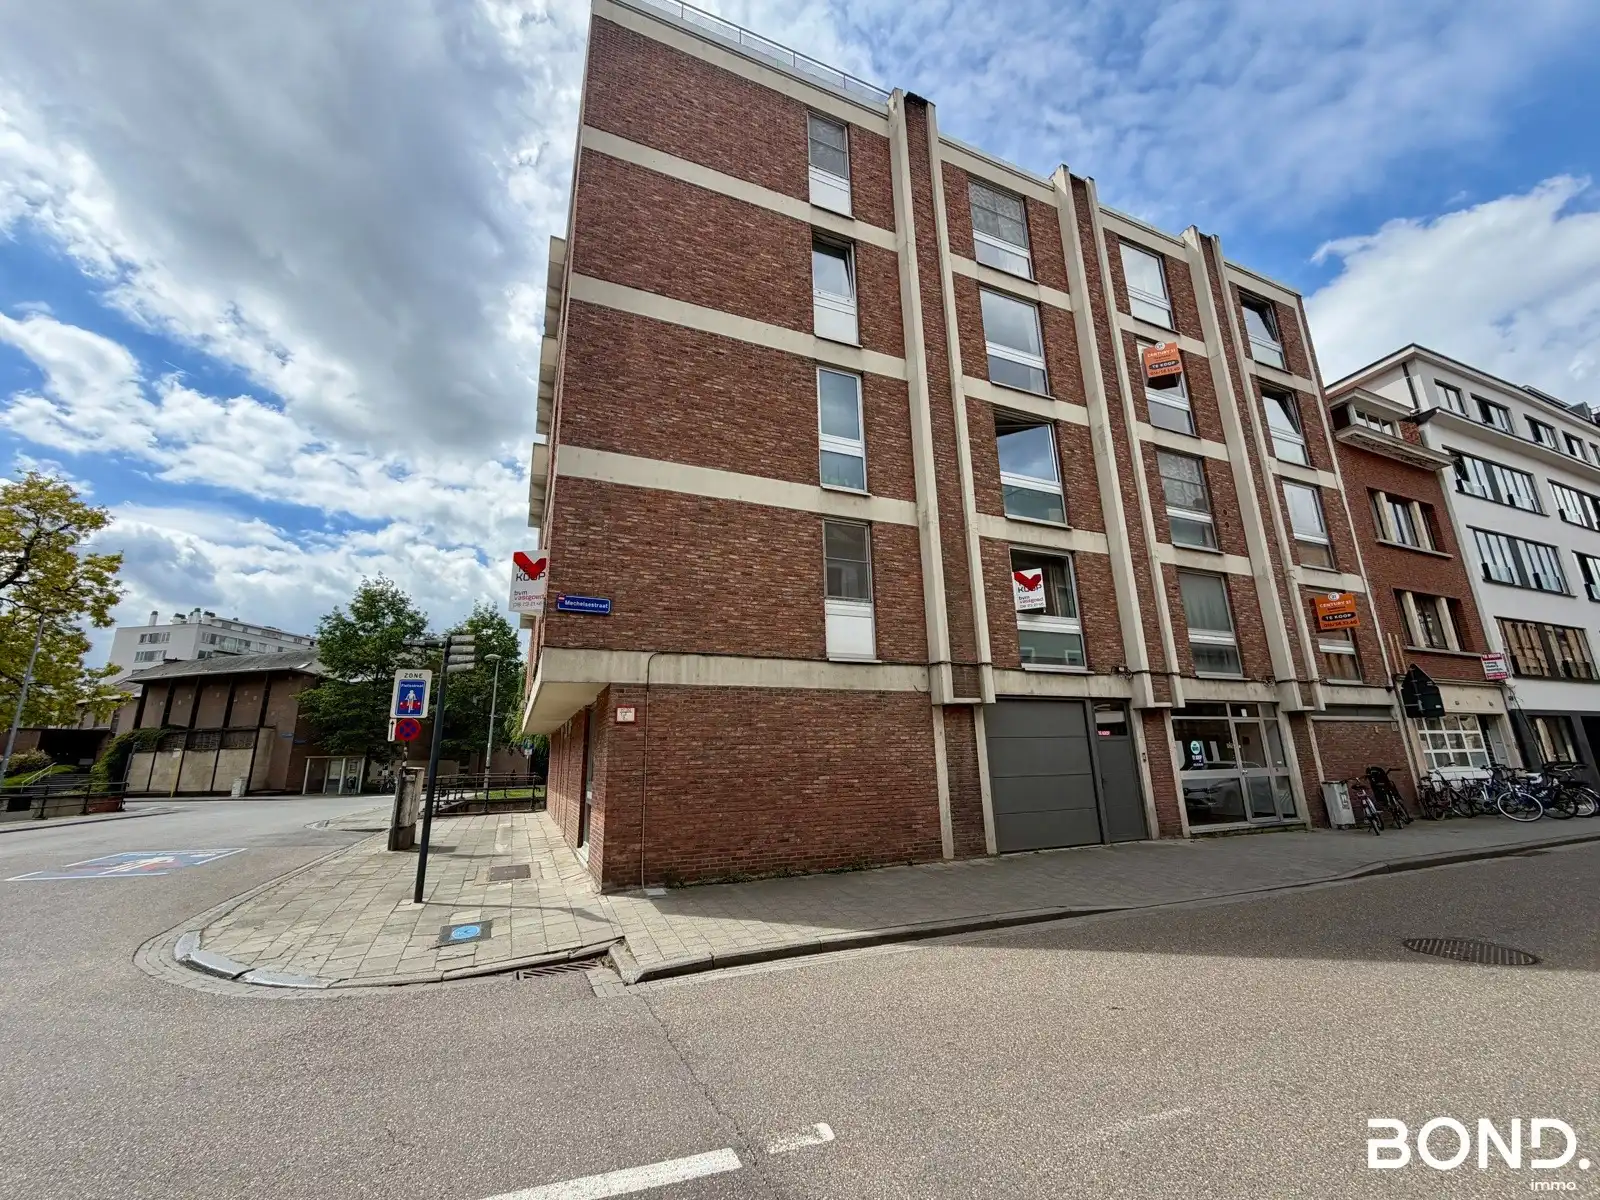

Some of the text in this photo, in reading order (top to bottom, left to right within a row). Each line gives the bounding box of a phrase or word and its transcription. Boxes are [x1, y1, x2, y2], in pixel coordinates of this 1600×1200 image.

[1147, 349, 1170, 358] CENTURY
[564, 599, 608, 609] Mechelsestraat
[1319, 600, 1345, 608] CENTURY
